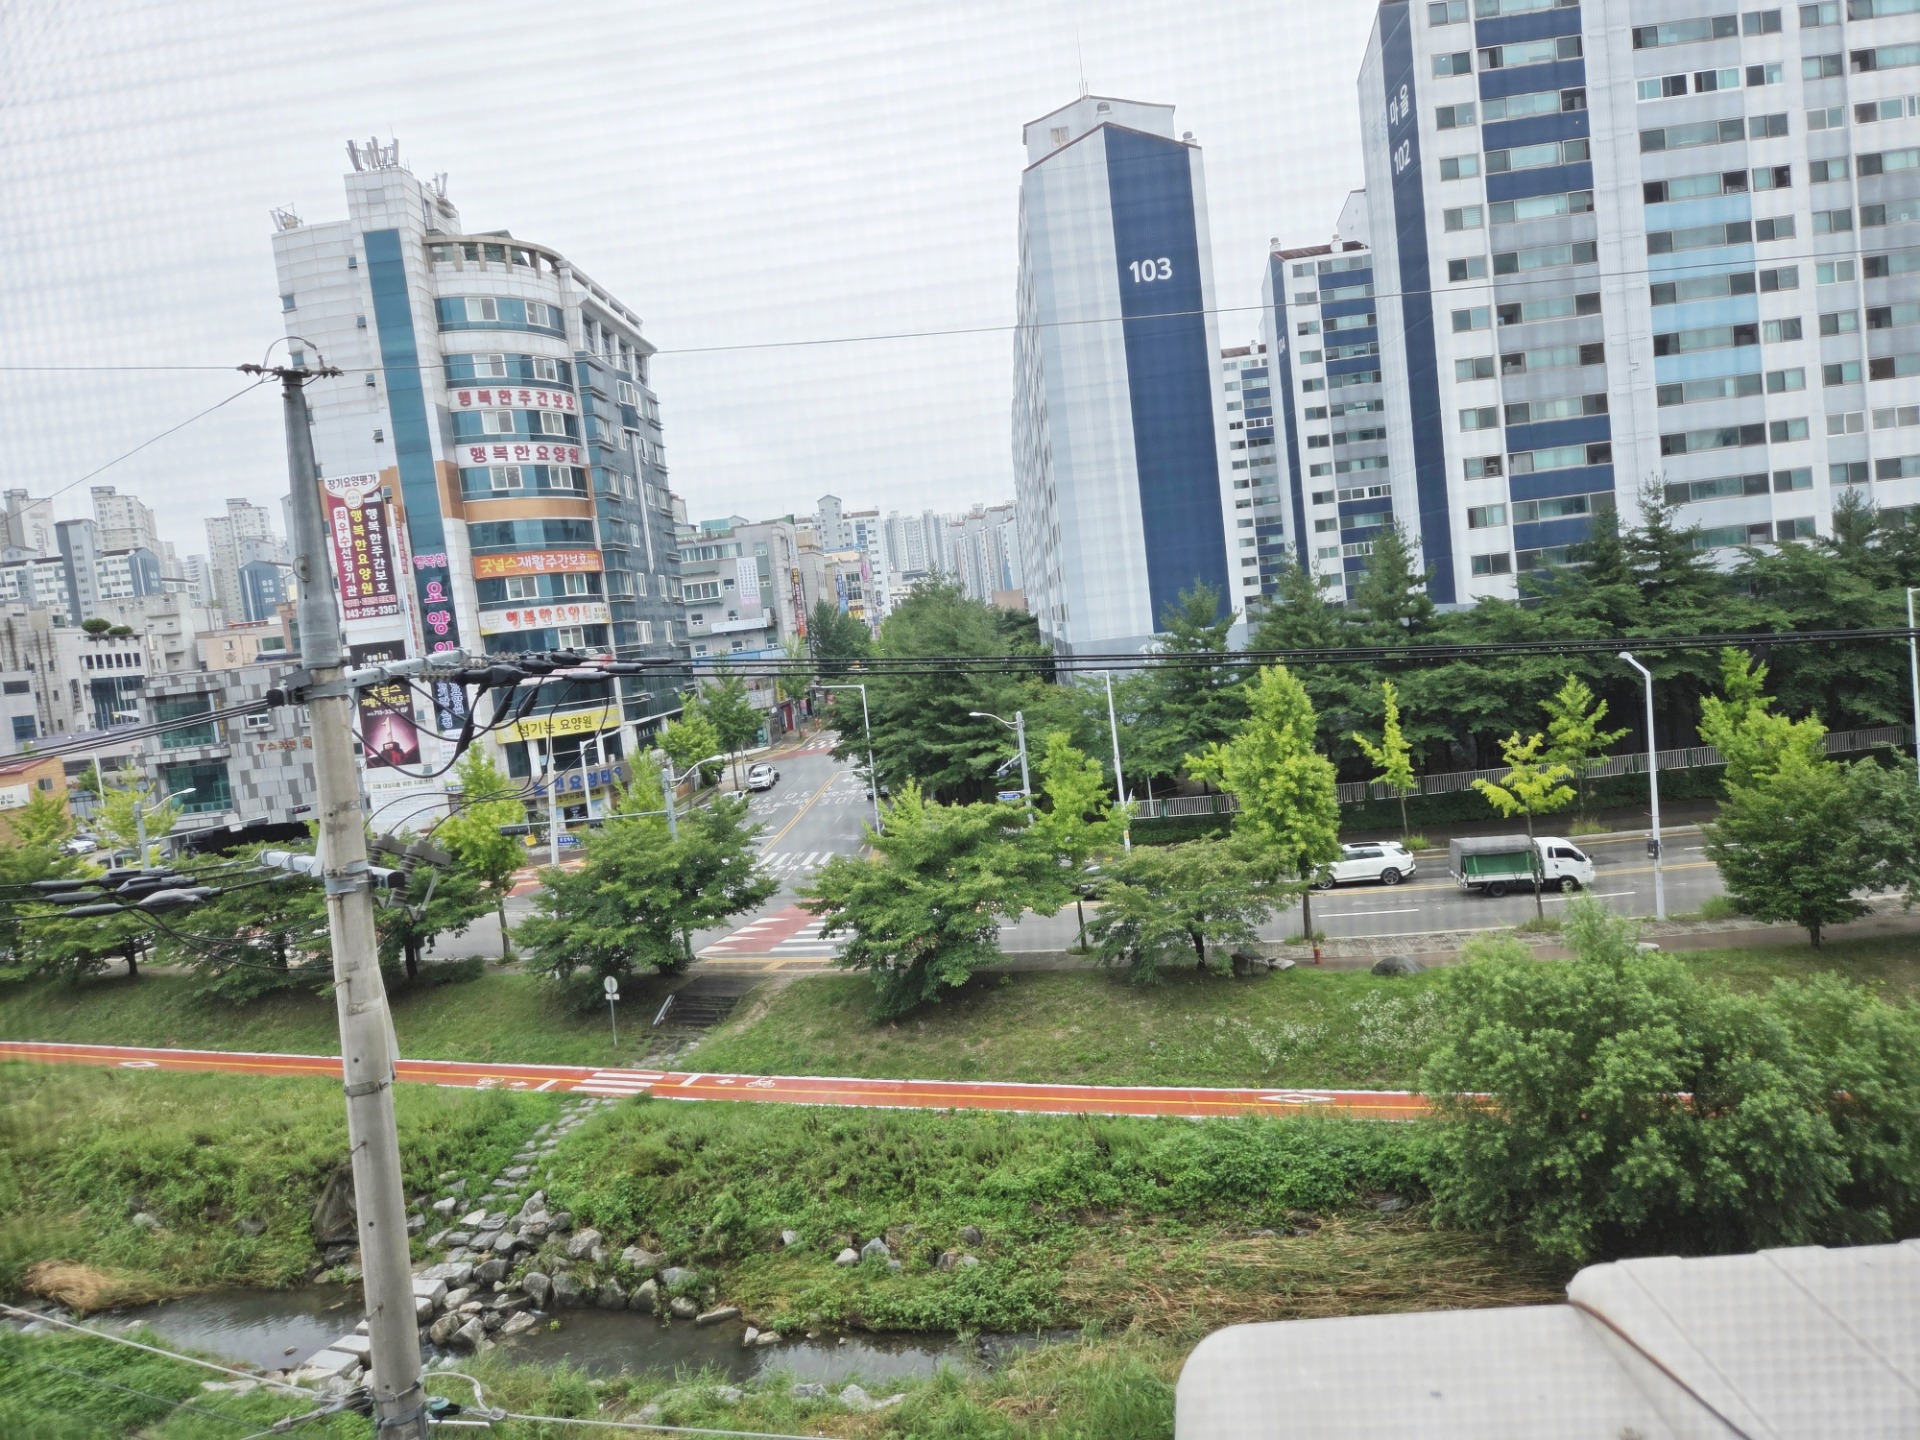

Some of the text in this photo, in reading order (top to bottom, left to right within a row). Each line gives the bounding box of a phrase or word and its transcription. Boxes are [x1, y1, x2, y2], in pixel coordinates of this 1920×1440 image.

[1389, 83, 1410, 127] 마을
[1394, 138, 1411, 175] 102
[1129, 257, 1172, 283] 103
[327, 474, 377, 490] 장기요양평가
[412, 553, 447, 570] 행복한
[346, 604, 398, 618] 043-255-3367
[517, 722, 556, 738] 섬기는
[559, 715, 593, 730] 요양원
